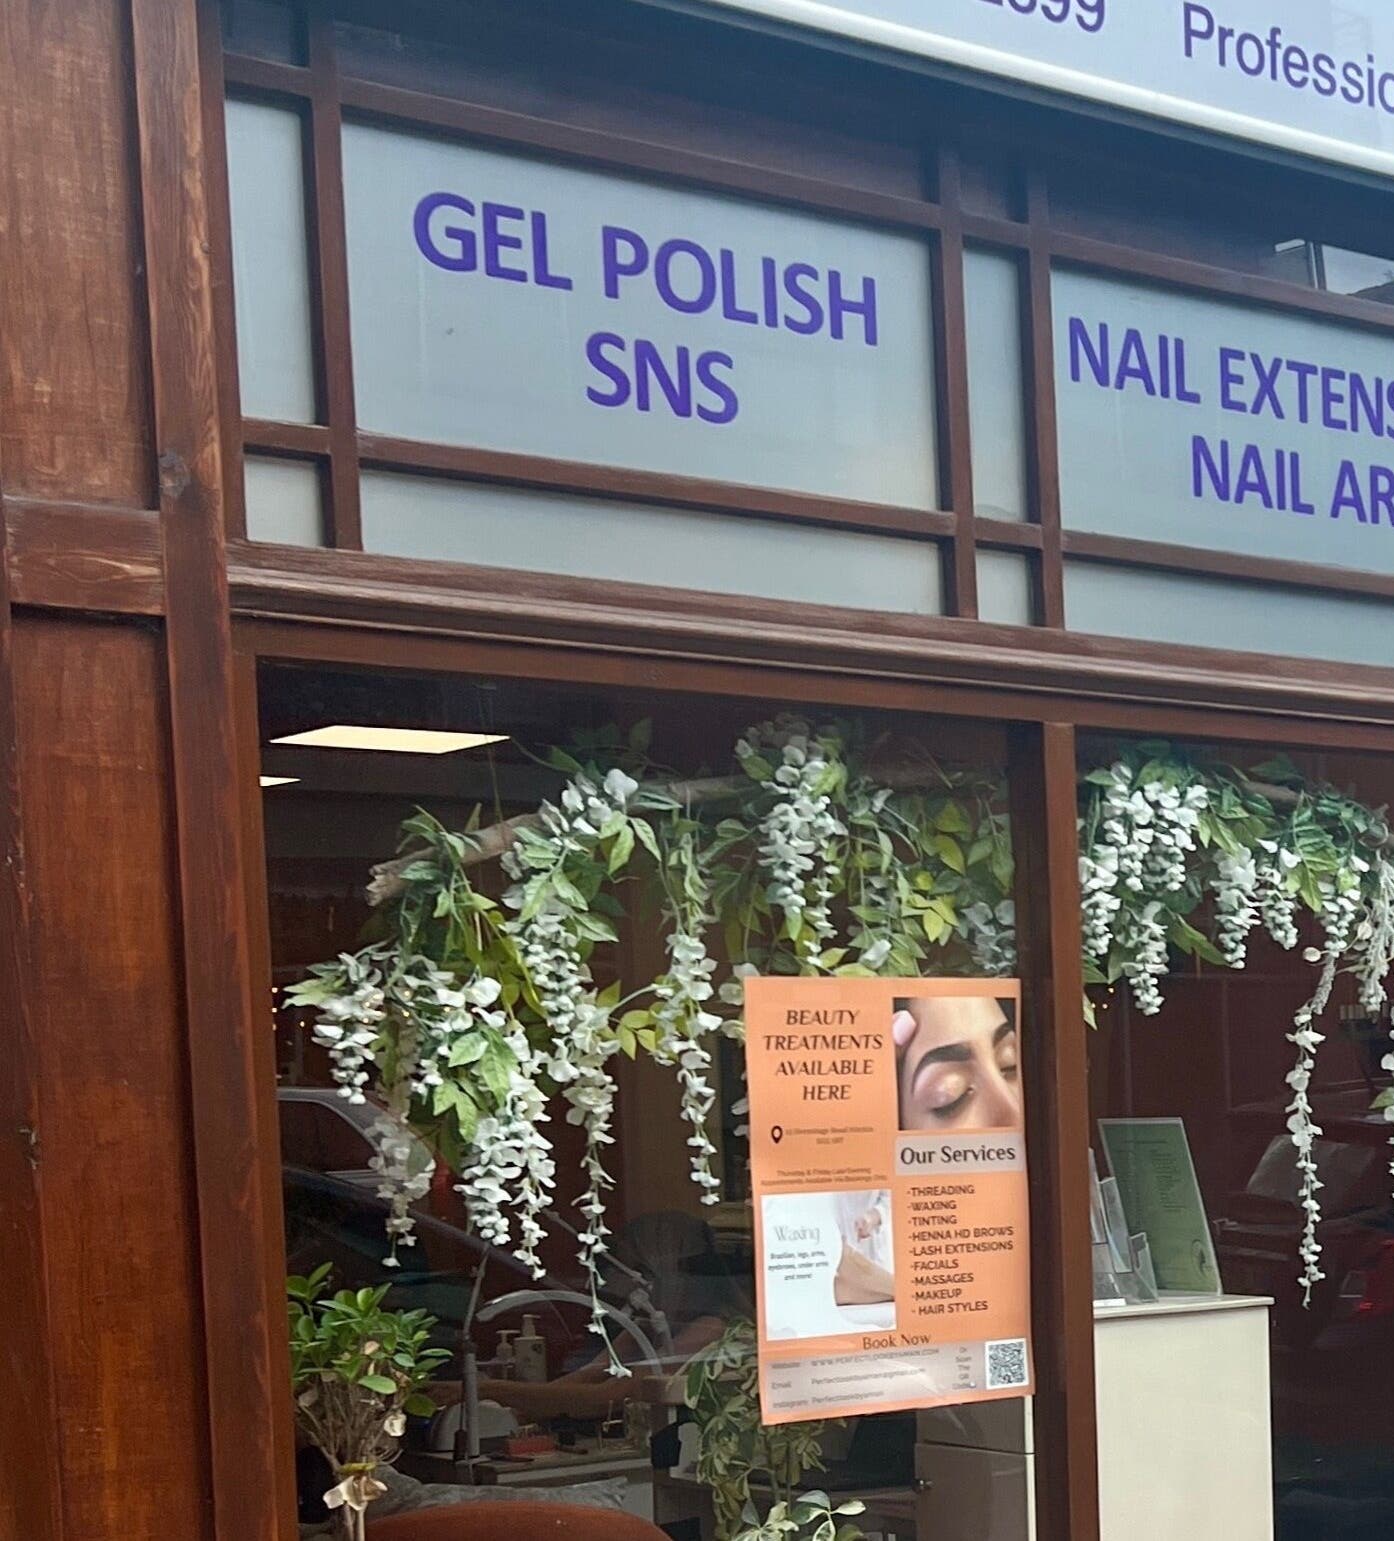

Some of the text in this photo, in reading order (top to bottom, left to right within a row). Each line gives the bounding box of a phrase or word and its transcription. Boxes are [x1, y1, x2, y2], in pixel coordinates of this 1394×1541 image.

[412, 191, 879, 347] GEL POLISH
[1068, 316, 1201, 405] NAIL
[585, 331, 740, 425] SNS
[1191, 434, 1315, 516] NAIL
[786, 1009, 860, 1026] BEAUTY
[763, 1033, 883, 1051] TREATMENTS
[775, 1059, 875, 1076] AVAILABLE
[802, 1085, 851, 1101] HERE
[900, 1144, 1016, 1165] Our Services
[954, 1228, 971, 1239] HD
[973, 1226, 1015, 1239] BROWS
[945, 1240, 1014, 1255] EXTENSIONS
[918, 1304, 945, 1315] HAIR
[947, 1301, 989, 1313] STYLES
[862, 1333, 932, 1350] Book Now
